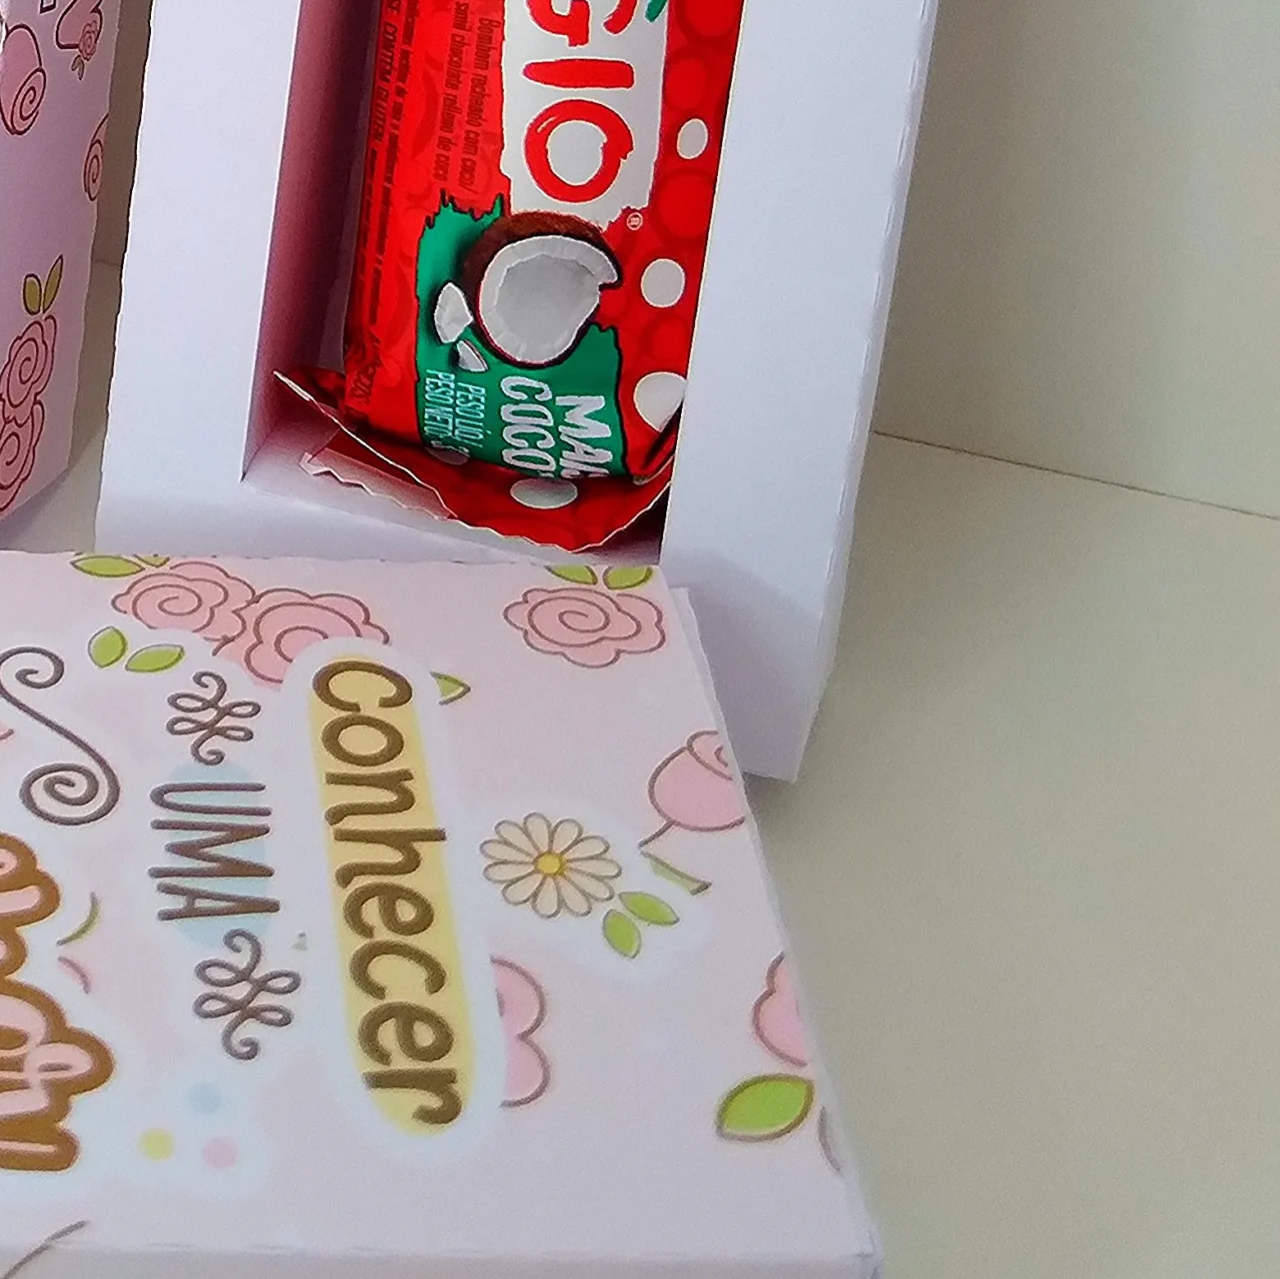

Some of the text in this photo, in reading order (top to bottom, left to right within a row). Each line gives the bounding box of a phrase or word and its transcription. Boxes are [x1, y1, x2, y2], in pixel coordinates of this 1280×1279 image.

[444, 33, 470, 90] chocolate
[466, 74, 492, 127] recheado
[437, 136, 458, 151] de
[463, 130, 482, 155] com
[433, 153, 451, 182] coco
[424, 369, 456, 405] PESO
[455, 382, 486, 419] PESO
[150, 782, 280, 922] UMA
[313, 659, 464, 1128] Conhecer
